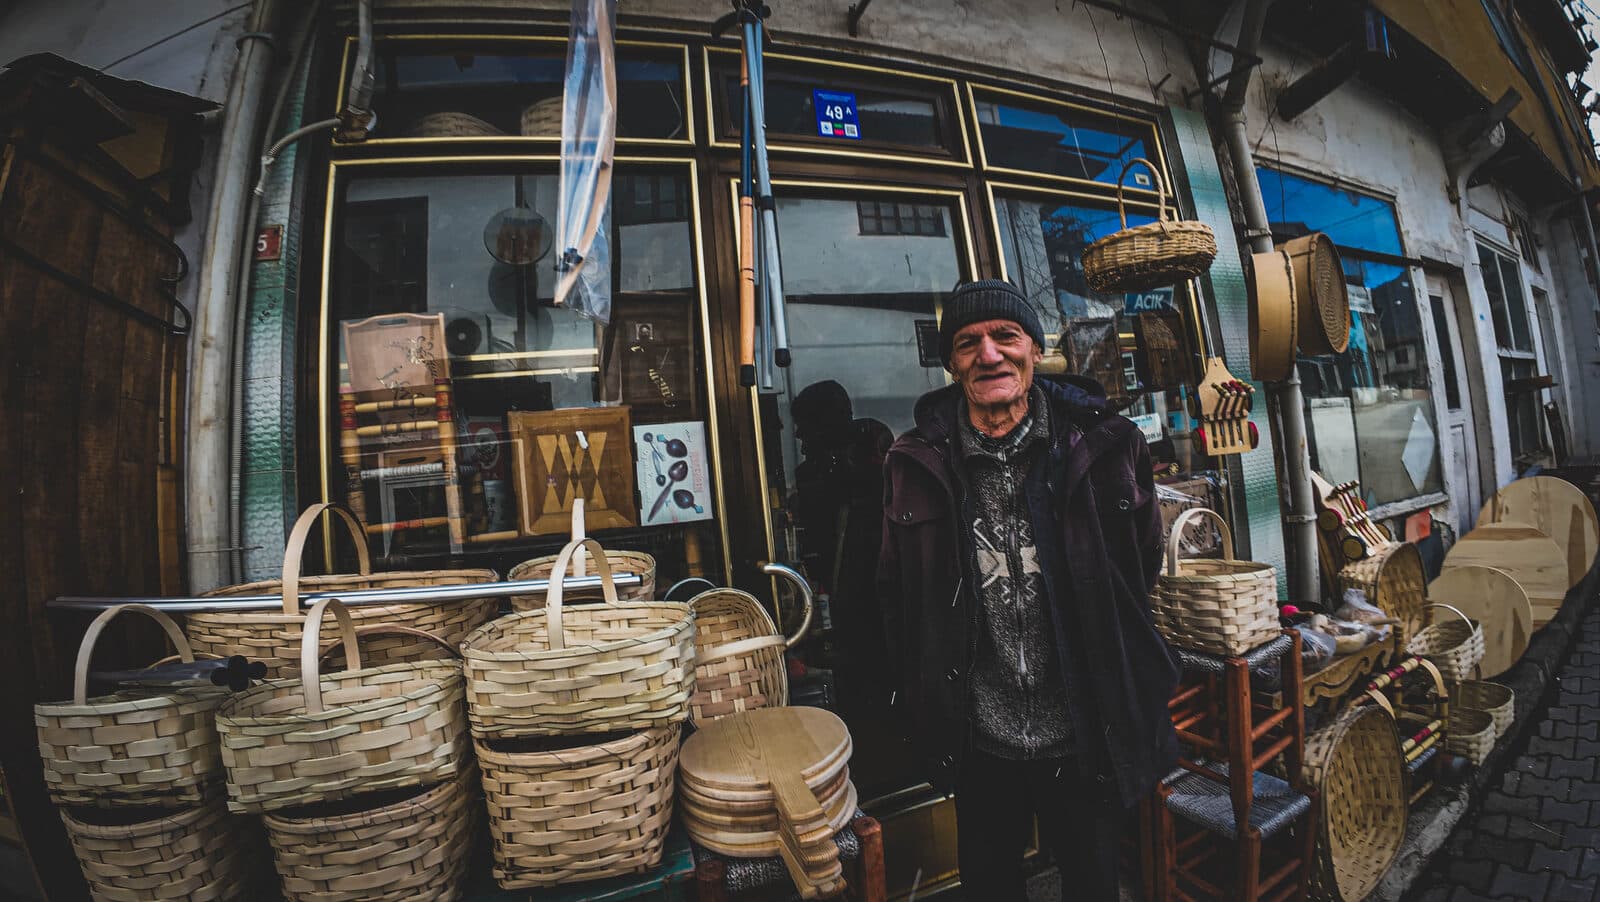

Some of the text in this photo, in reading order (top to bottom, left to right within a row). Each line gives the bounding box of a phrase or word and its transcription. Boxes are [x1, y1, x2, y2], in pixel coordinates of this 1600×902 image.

[826, 105, 852, 120] 49 A
[257, 234, 268, 252] 5
